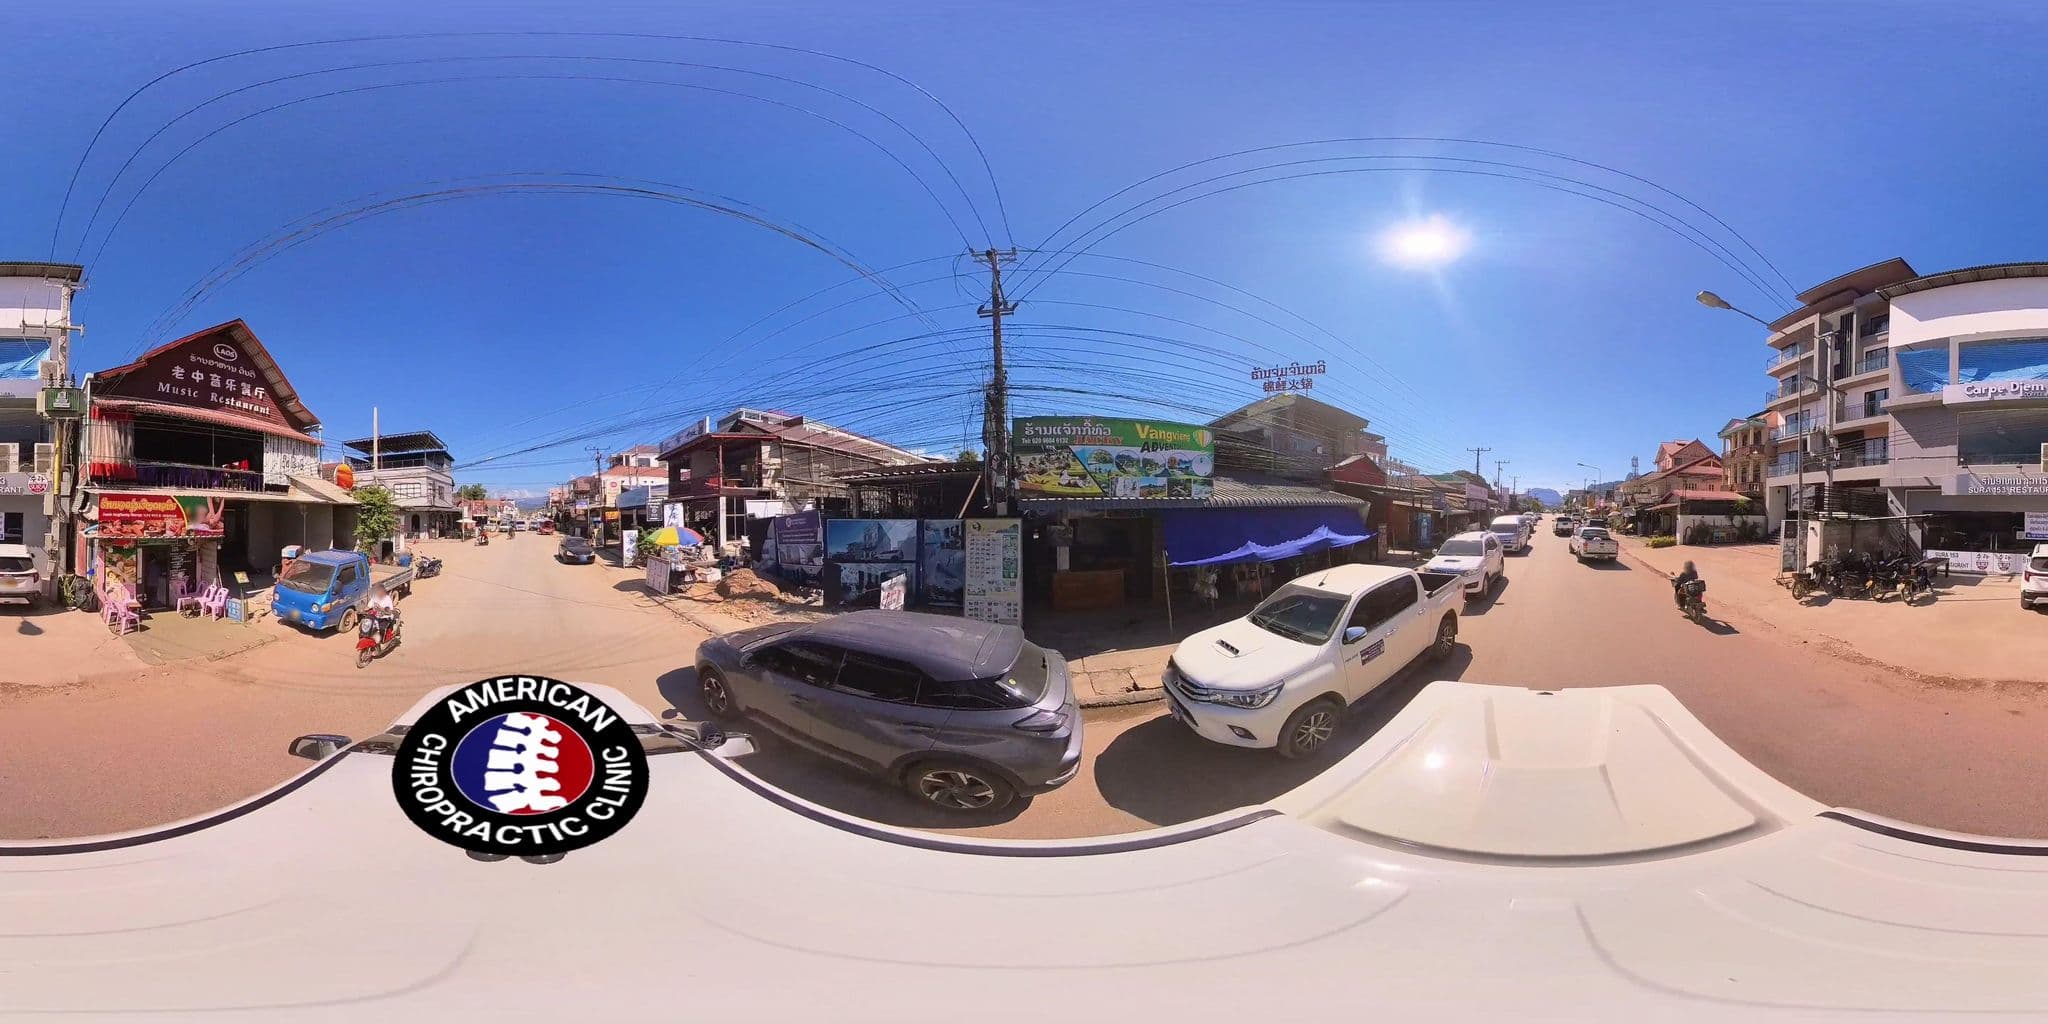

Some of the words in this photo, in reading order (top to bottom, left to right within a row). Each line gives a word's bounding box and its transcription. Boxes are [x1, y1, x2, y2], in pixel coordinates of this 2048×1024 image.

[216, 347, 235, 358] LAOS
[171, 365, 265, 399] 老中音乐餐厅
[1964, 385, 2006, 400] Carpe
[2010, 381, 2045, 397] Diem
[158, 382, 199, 398] Music
[210, 392, 270, 415] Restaurant
[1968, 486, 1992, 494] SURA
